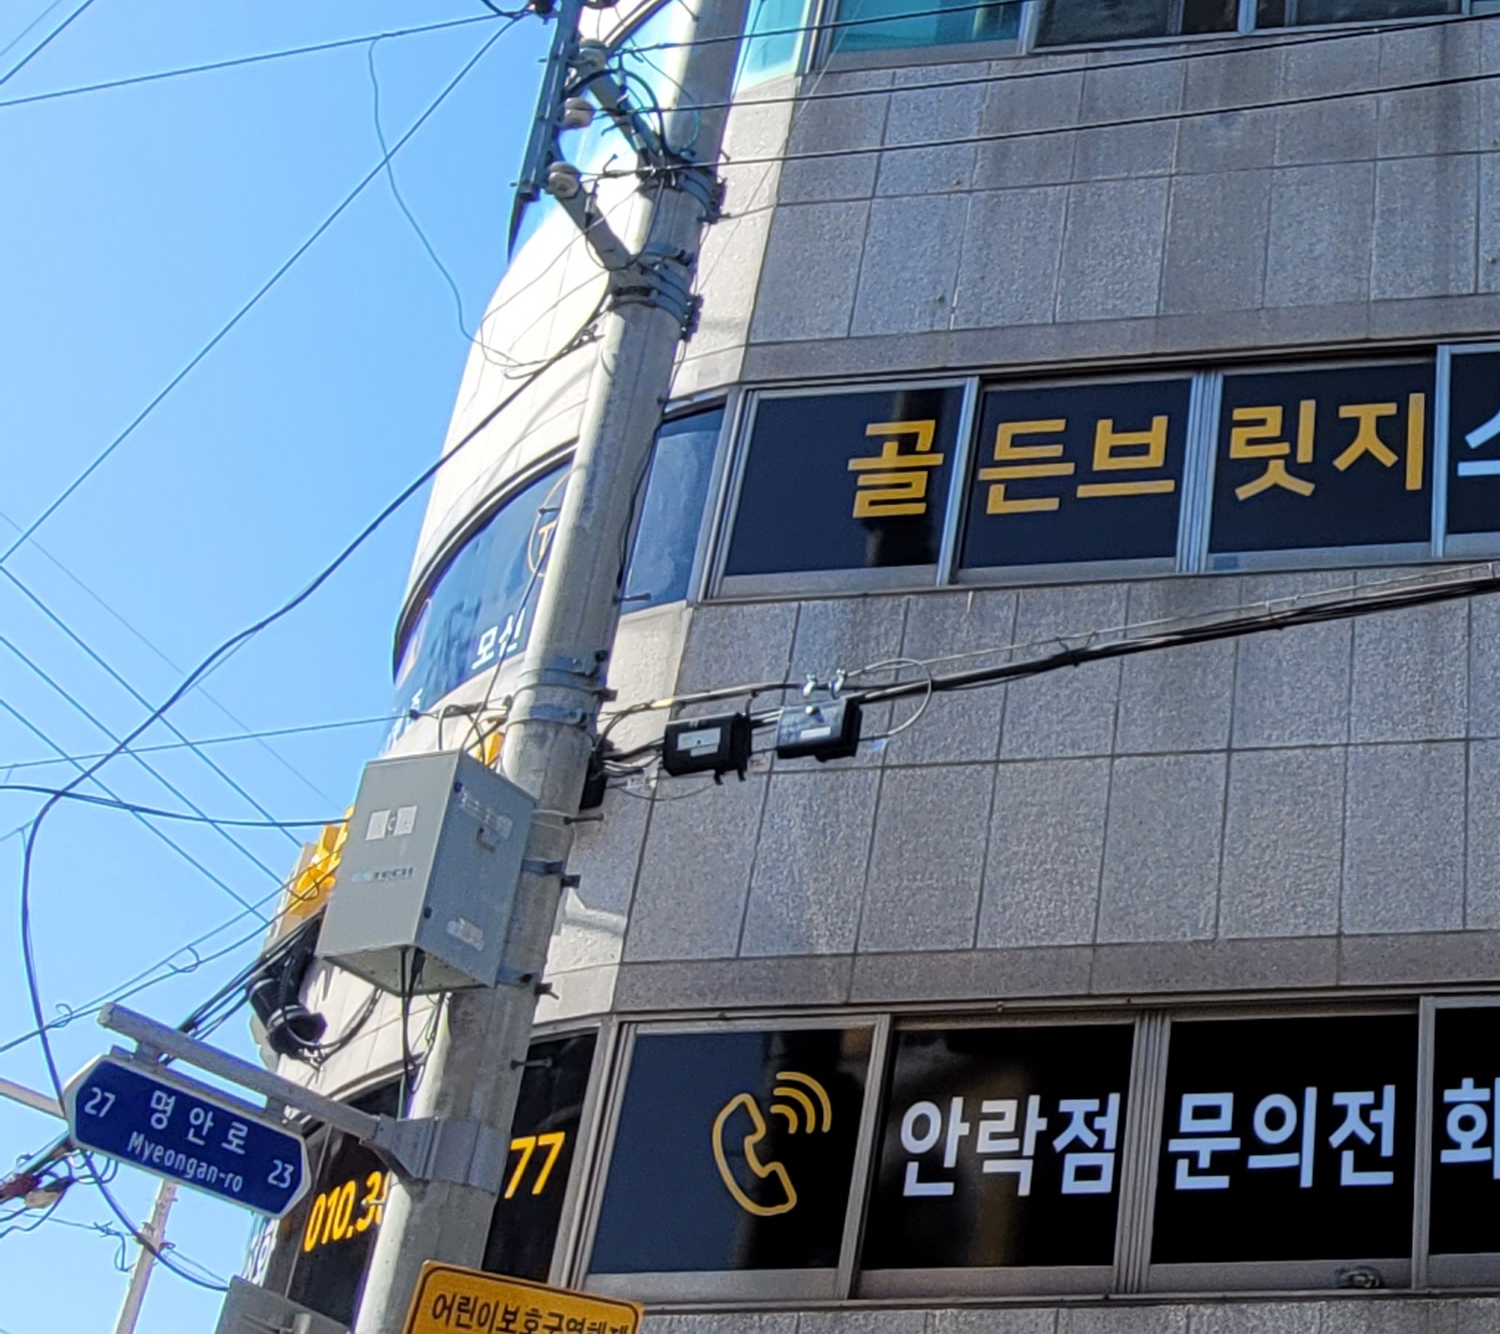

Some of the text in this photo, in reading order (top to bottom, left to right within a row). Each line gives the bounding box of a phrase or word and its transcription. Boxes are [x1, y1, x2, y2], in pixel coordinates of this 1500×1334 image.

[847, 393, 1425, 518] 골든브릿지
[84, 1087, 116, 1118] 27
[149, 1089, 249, 1155] 명안로
[126, 1131, 244, 1193] Myeongan-ro
[267, 1159, 295, 1189] 23
[899, 1093, 1121, 1196] 안락점
